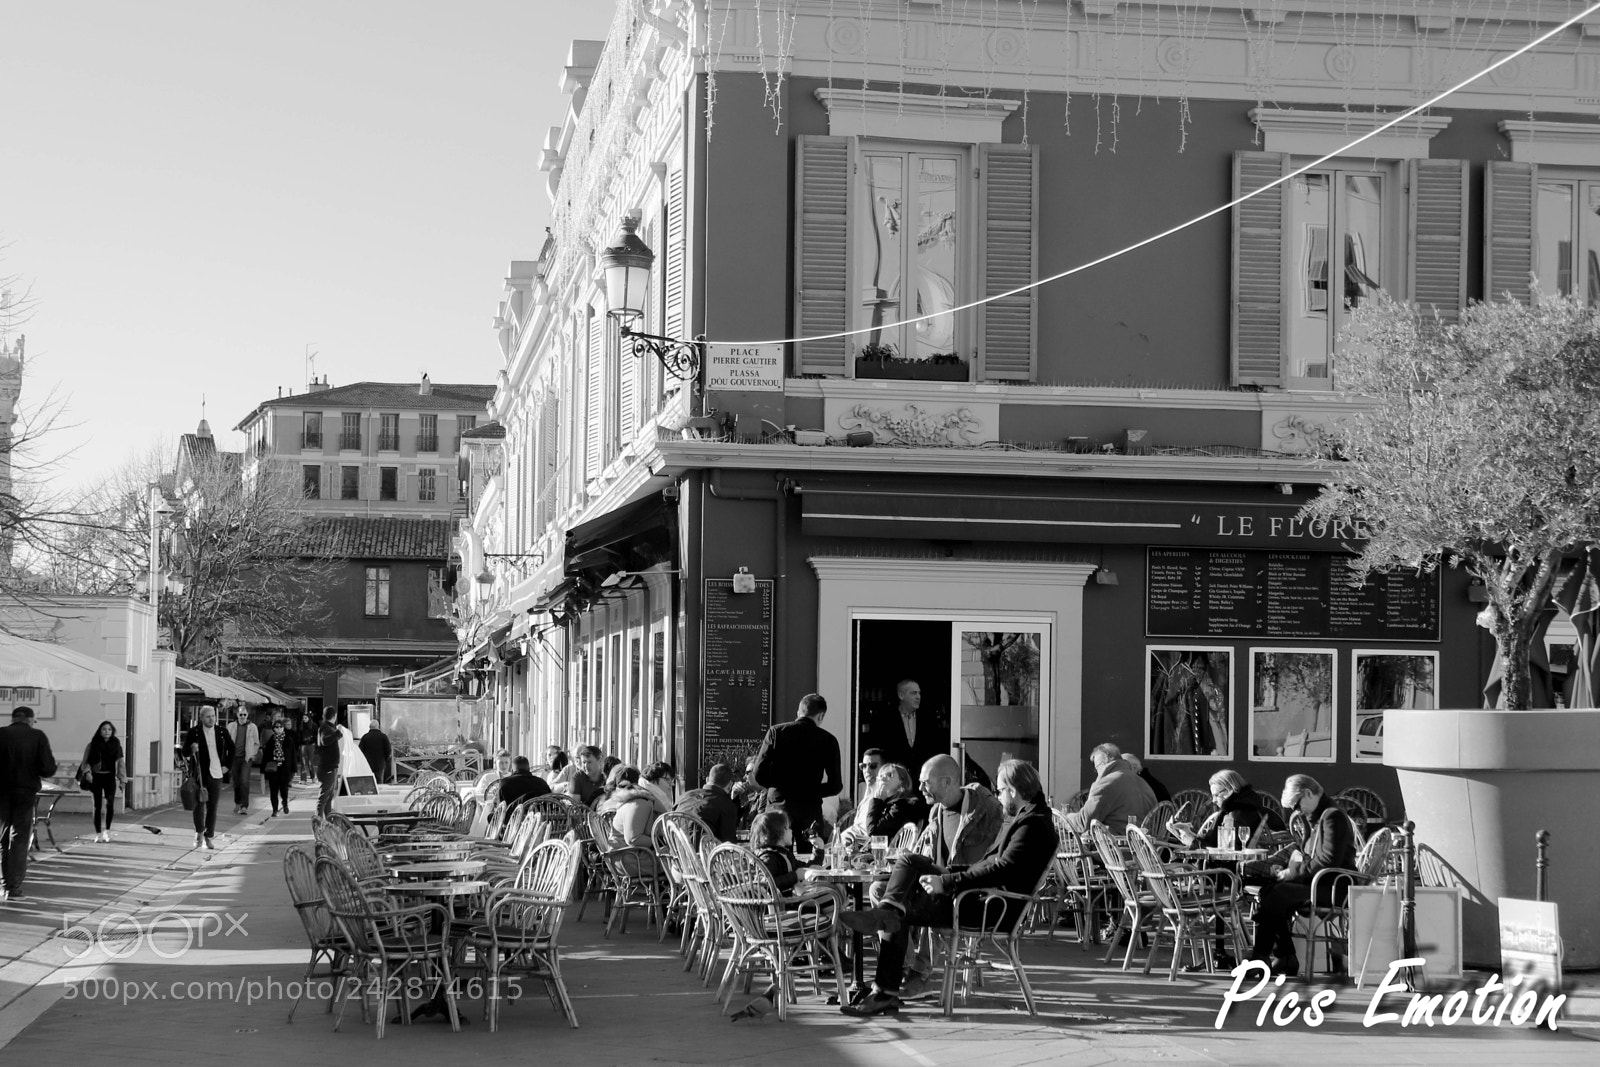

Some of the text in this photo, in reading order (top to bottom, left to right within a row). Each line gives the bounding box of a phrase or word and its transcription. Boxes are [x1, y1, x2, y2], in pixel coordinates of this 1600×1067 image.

[730, 348, 760, 356] PLACE
[742, 357, 777, 365] GAUTIER
[730, 369, 760, 377] PLASSA
[730, 378, 779, 386] GOUVERNOU
[1217, 515, 1254, 536] LE
[1268, 516, 1370, 540] FLORE
